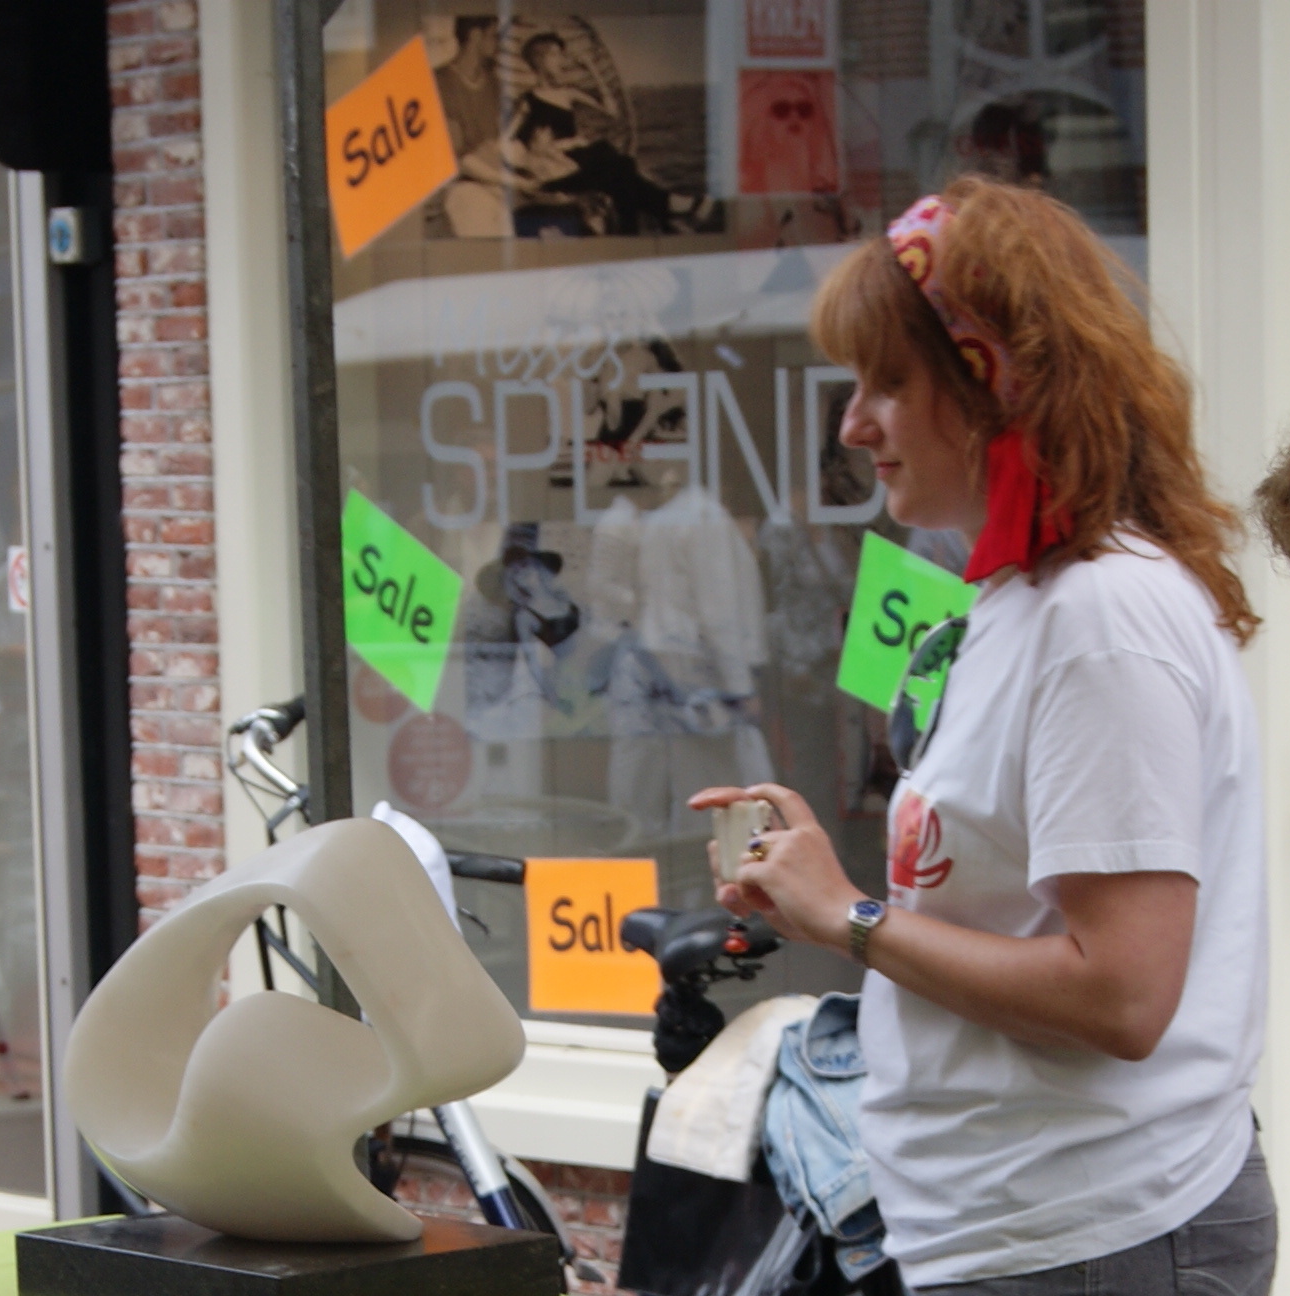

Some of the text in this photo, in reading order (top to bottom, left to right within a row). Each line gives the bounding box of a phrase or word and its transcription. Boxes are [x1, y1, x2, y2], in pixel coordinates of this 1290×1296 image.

[342, 93, 428, 188] Sale
[352, 543, 437, 645] Sale
[548, 891, 615, 953] Sal
